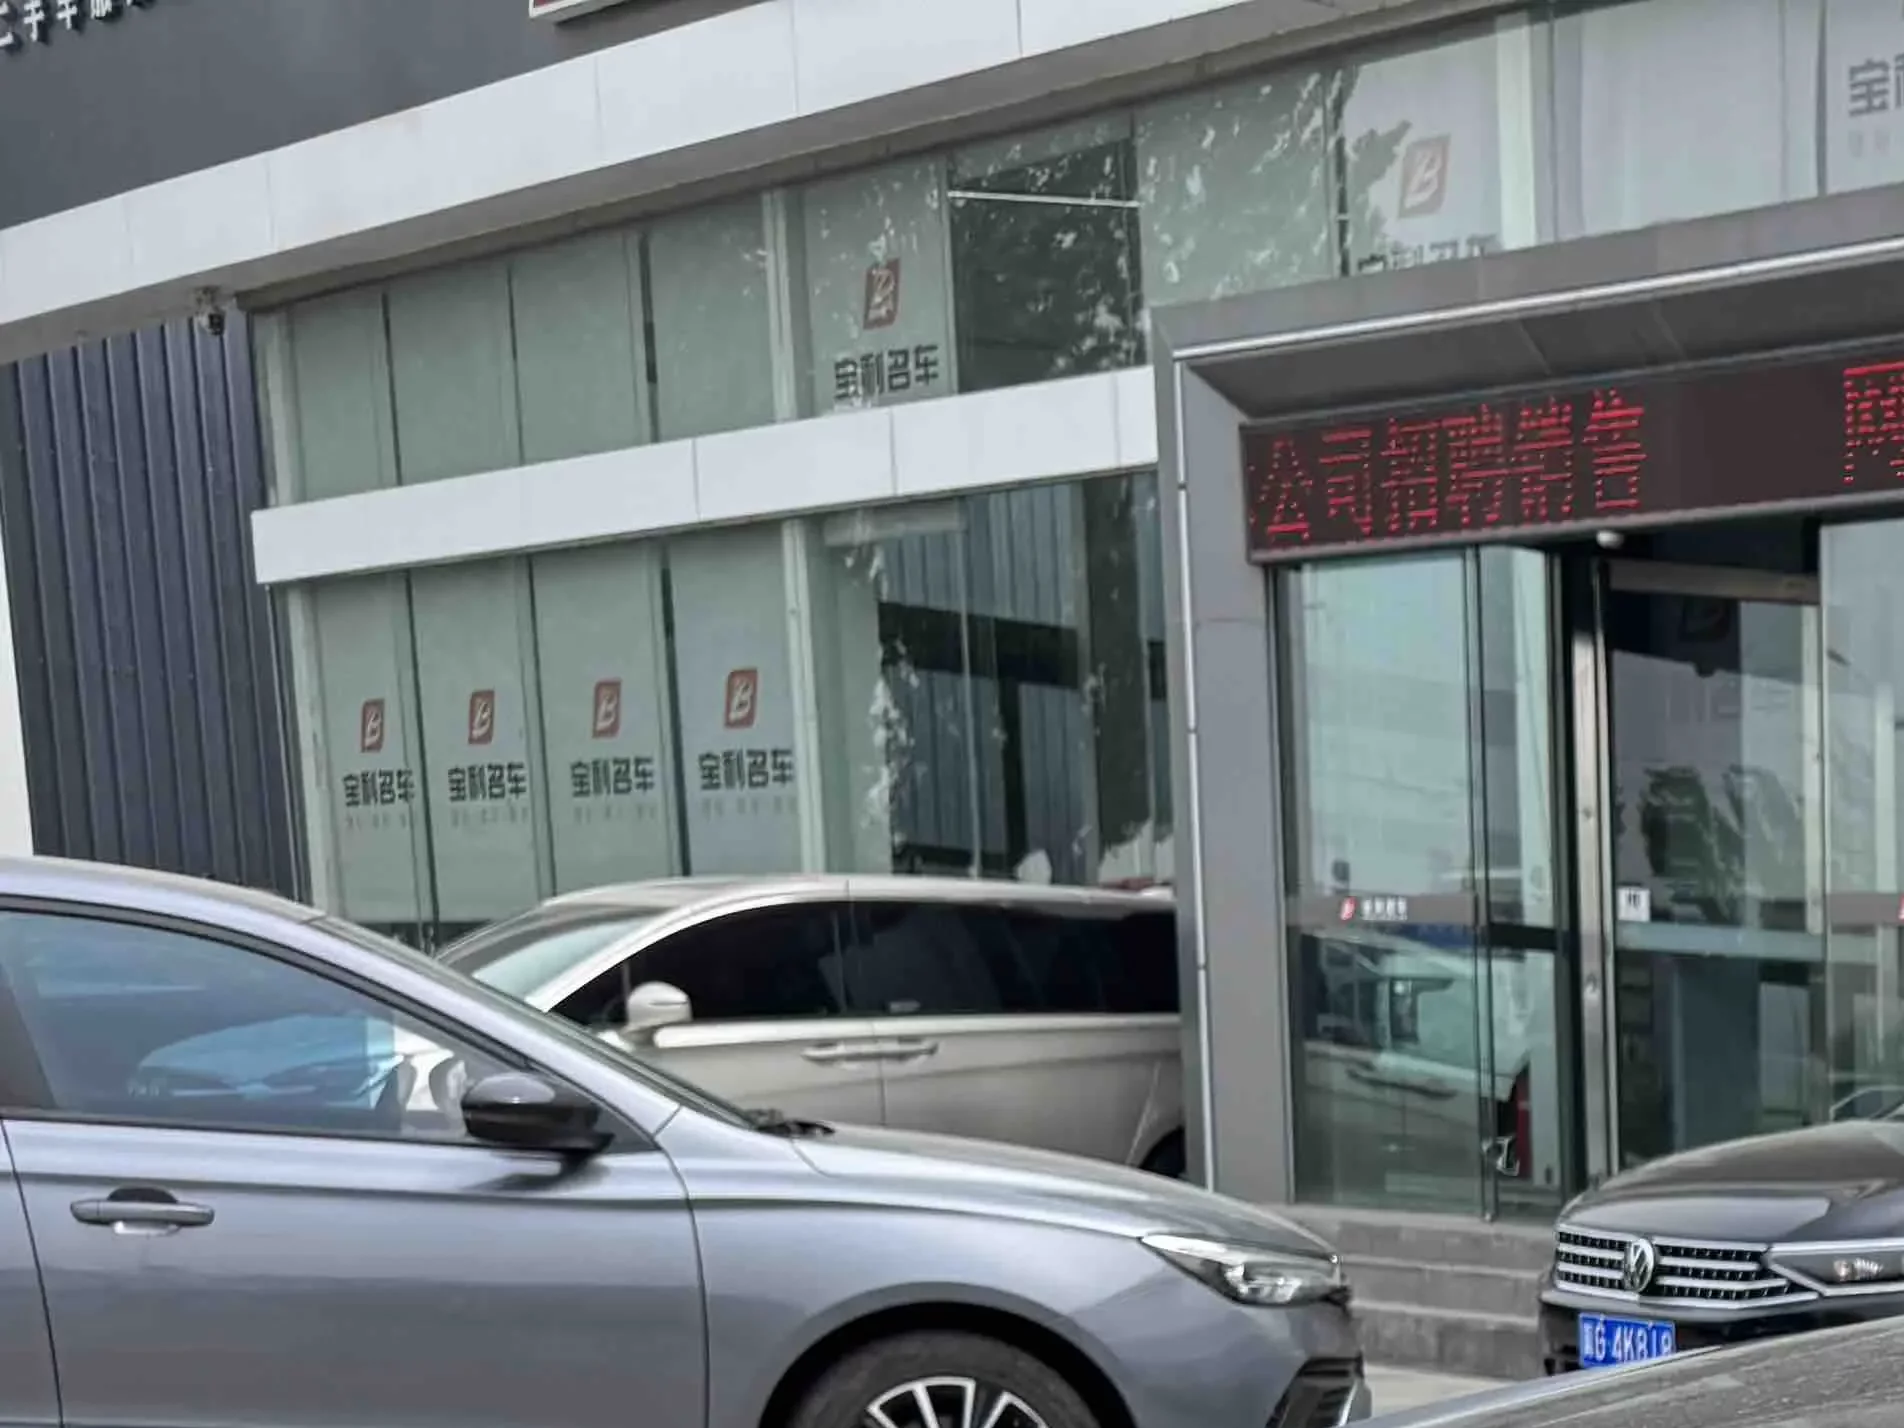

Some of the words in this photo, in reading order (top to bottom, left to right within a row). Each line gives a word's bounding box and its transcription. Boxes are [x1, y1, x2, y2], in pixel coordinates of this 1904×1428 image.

[833, 344, 939, 400] 宝利名车
[1259, 389, 1647, 543] 公司招聘销售
[341, 768, 415, 808] 宝利名车
[448, 761, 527, 803] 宝利名车
[570, 756, 655, 798] 宝利名车
[698, 748, 795, 792] 宝利名车
